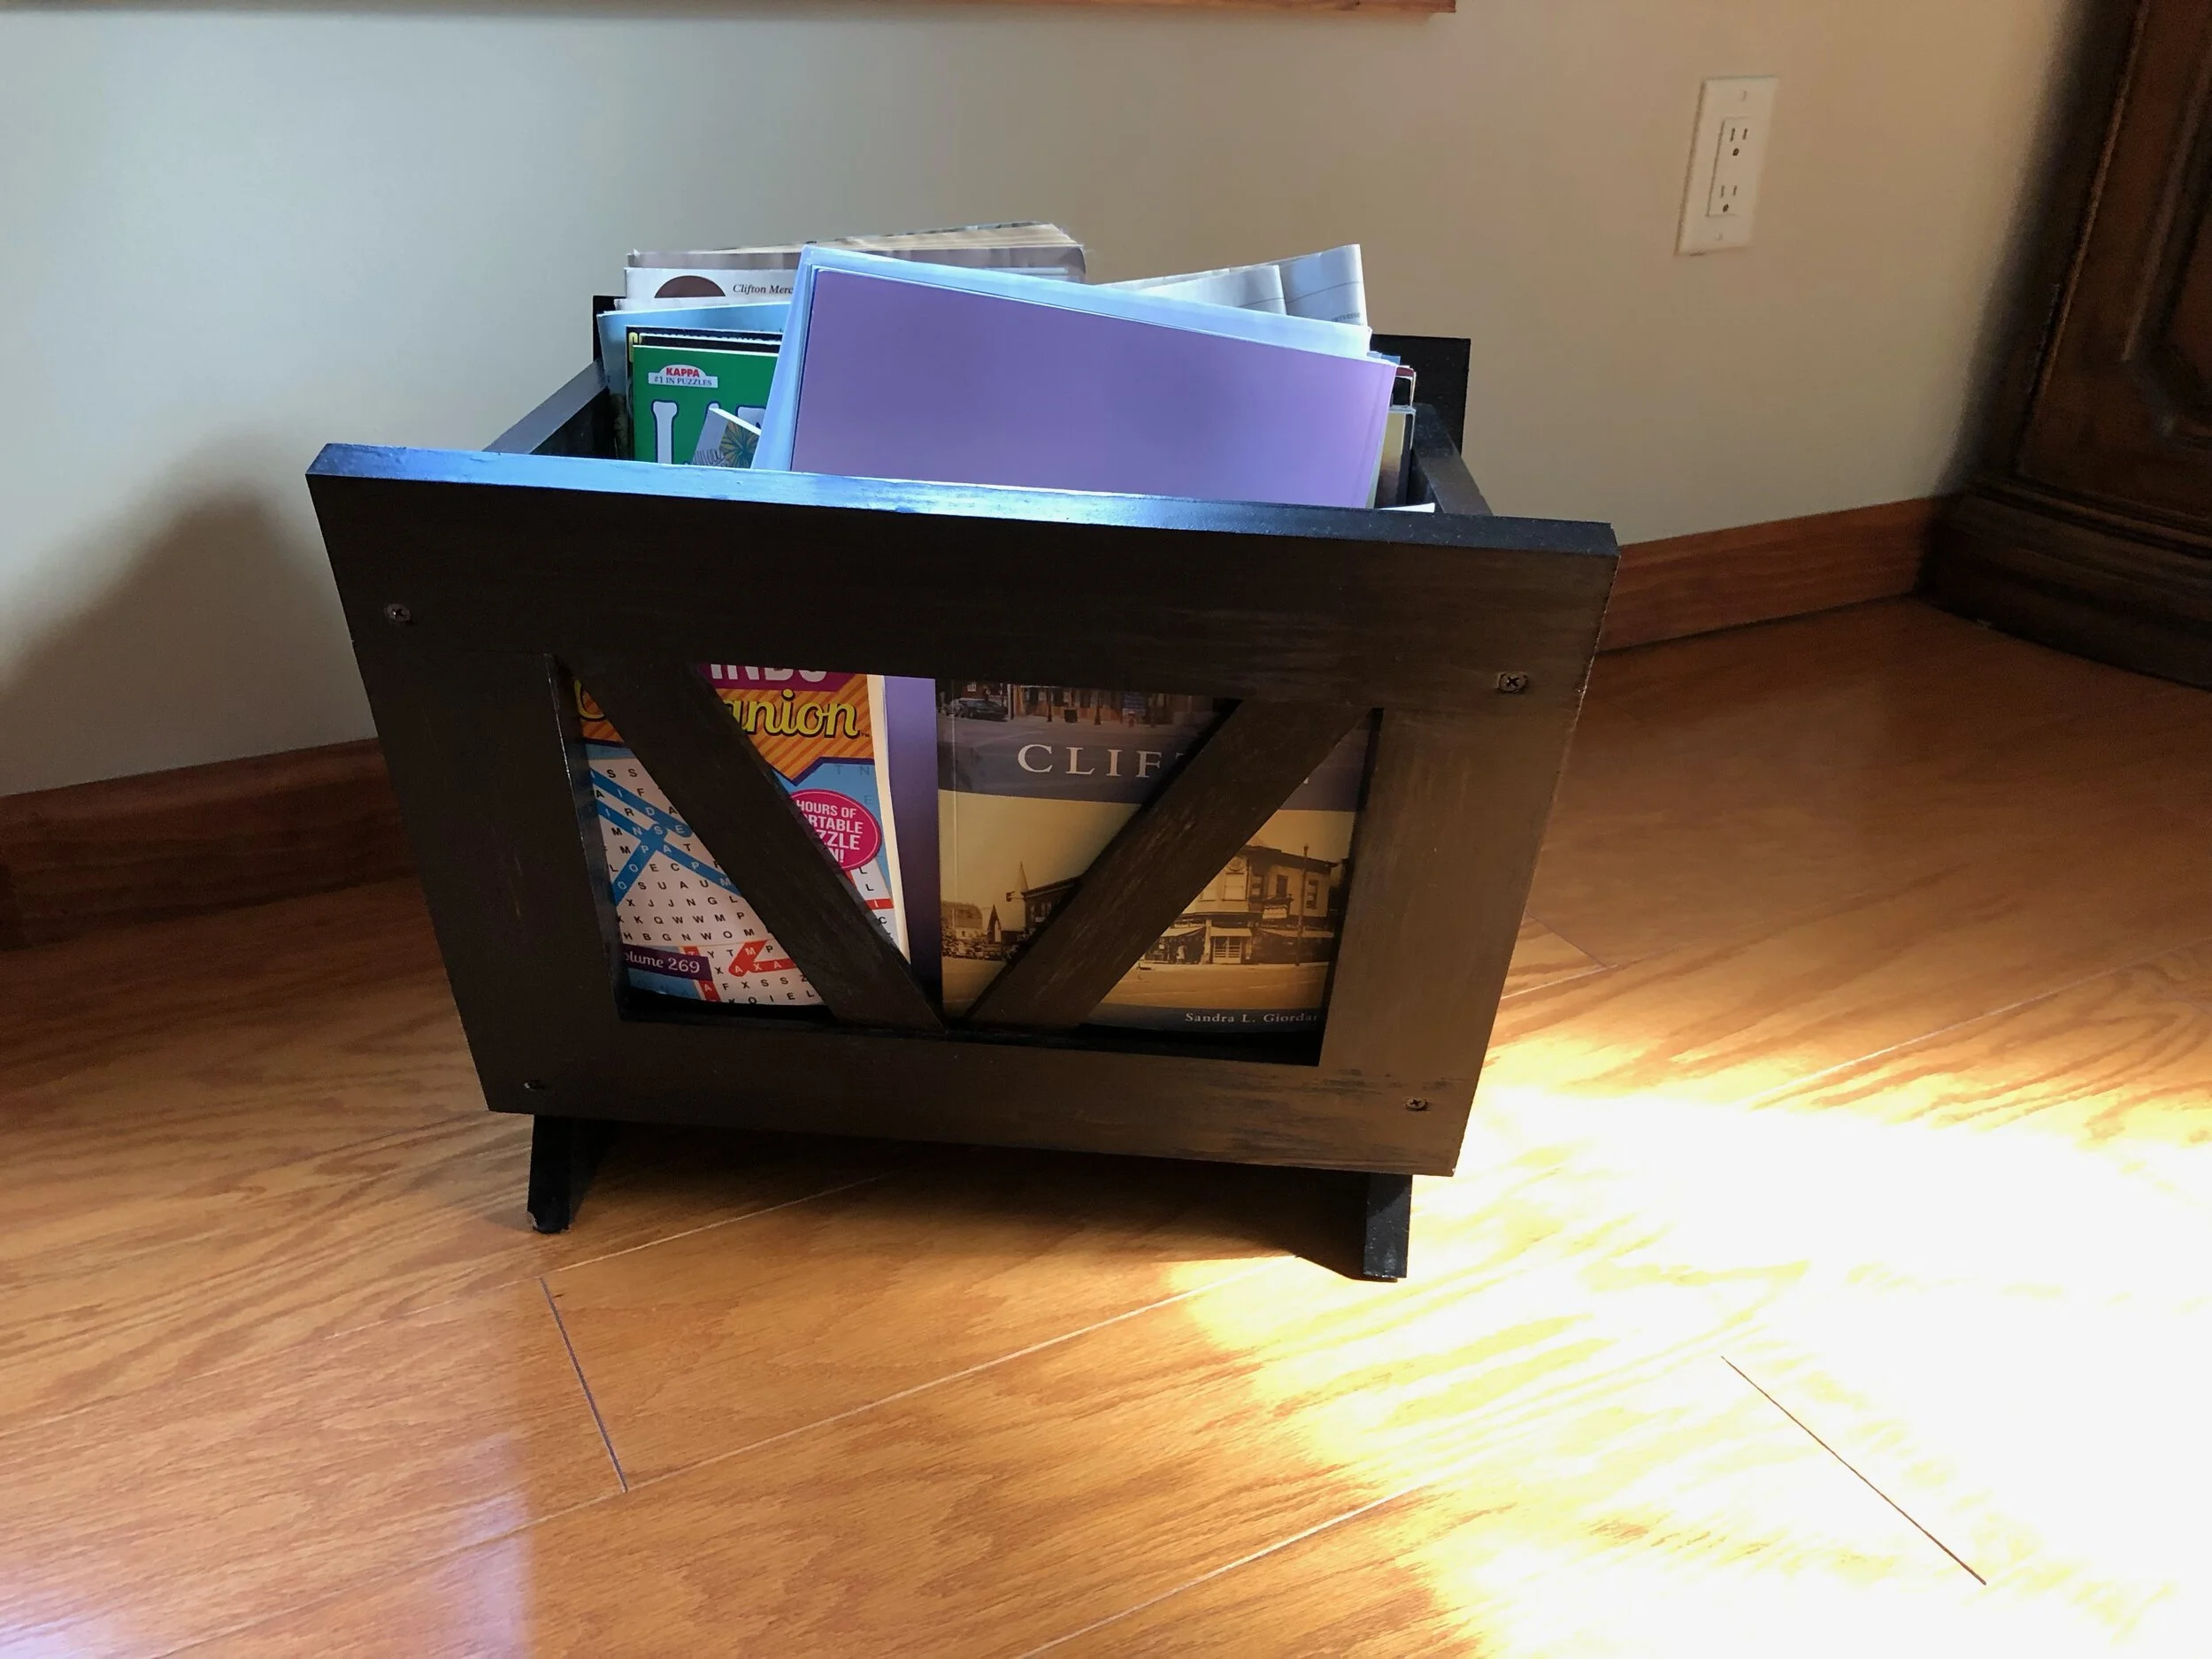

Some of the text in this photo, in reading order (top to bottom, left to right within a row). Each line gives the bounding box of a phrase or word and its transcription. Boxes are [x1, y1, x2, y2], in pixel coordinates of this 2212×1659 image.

[733, 284, 793, 296] Clifton Merc
[666, 367, 699, 377] KAPPA
[1018, 743, 1185, 779] CLIF
[841, 807, 856, 818] OF
[804, 813, 864, 834] RTABLE
[623, 950, 701, 974] olume 269
[1185, 1012, 1234, 1023] Sandra
[1242, 1014, 1256, 1023] L.
